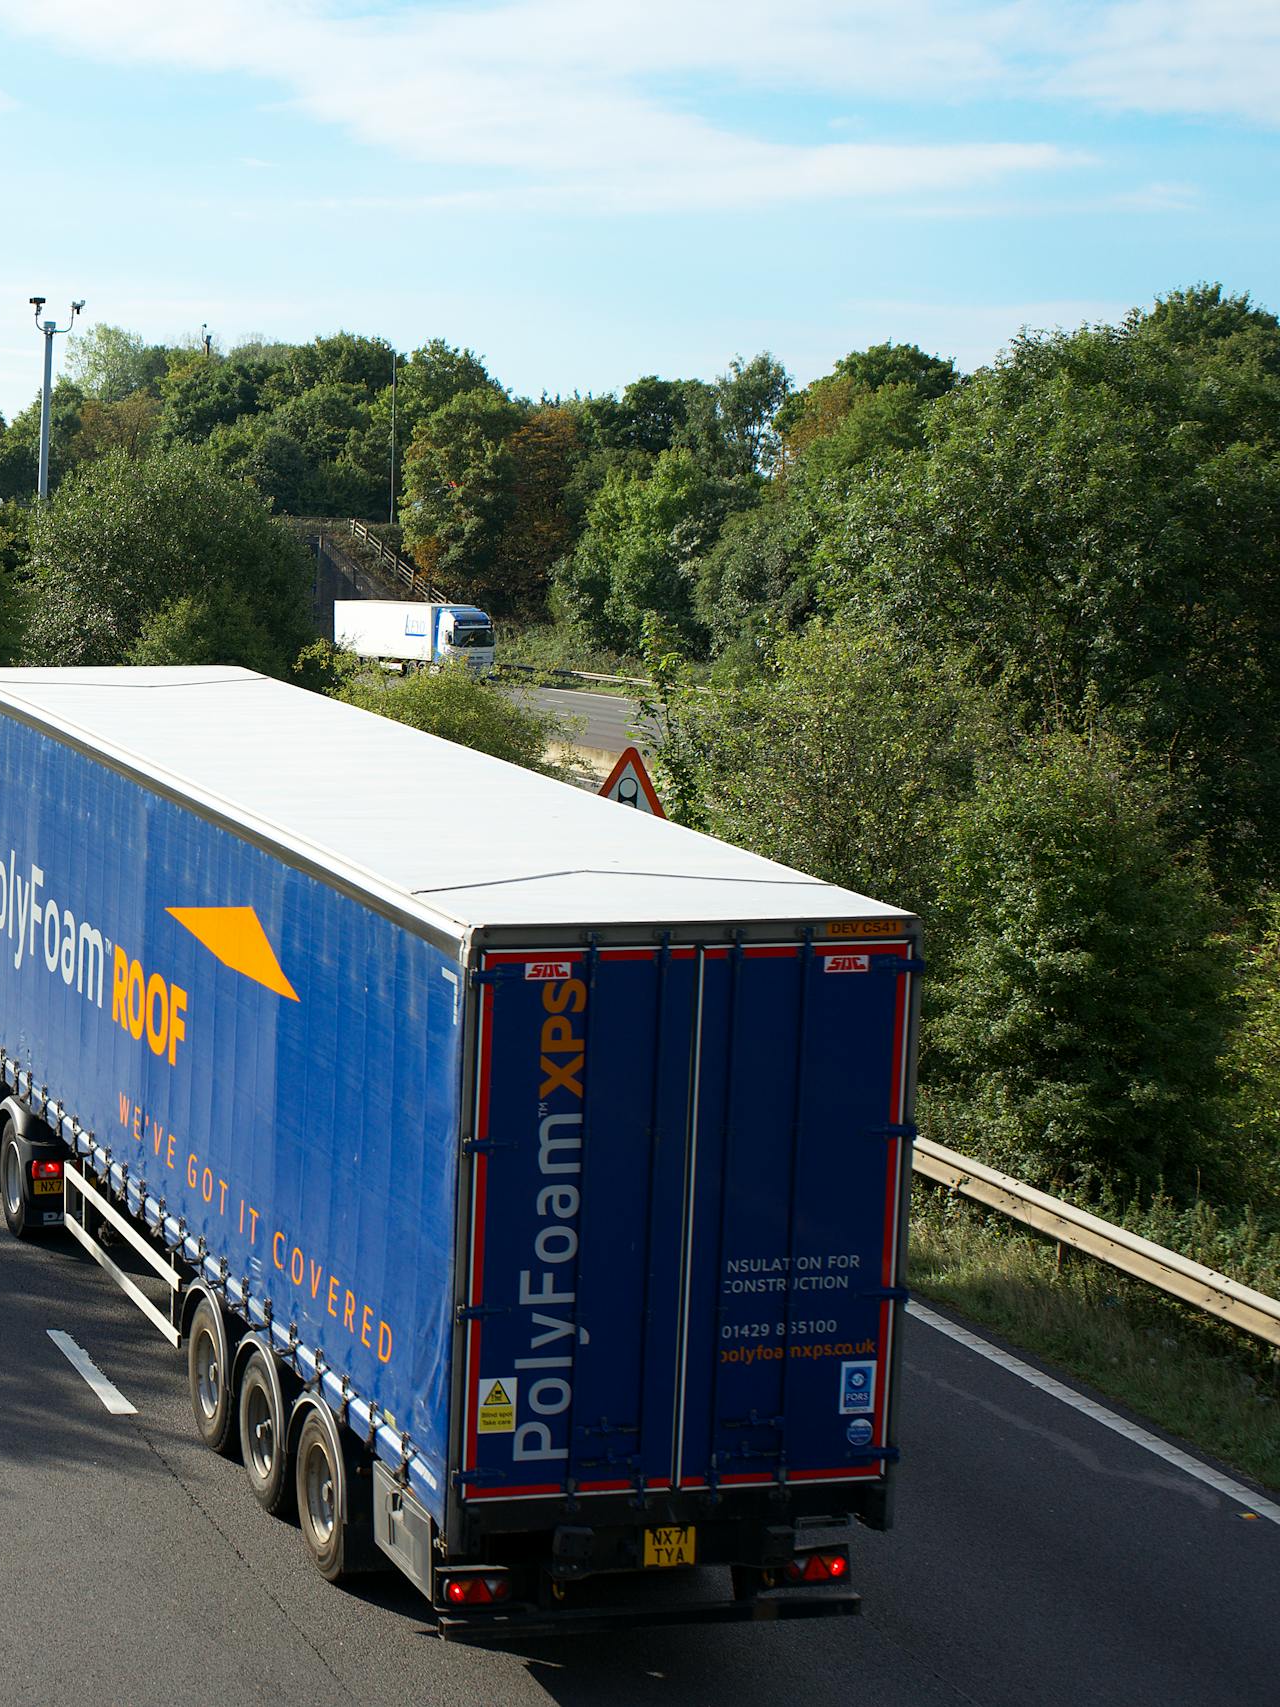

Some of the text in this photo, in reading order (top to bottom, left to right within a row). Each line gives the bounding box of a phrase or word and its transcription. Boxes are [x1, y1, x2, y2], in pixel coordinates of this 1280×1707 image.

[831, 921, 897, 934] DEV C541
[526, 963, 570, 979] SDC
[826, 956, 866, 971] SDC
[112, 944, 187, 1067] ROOF
[538, 978, 587, 1100] XPS
[40, 1180, 63, 1193] NX7
[119, 1091, 393, 1364] WE'VE GOT IT COVERED
[726, 1254, 860, 1273] NSULATON FOR
[721, 1323, 770, 1339] 01429
[846, 1392, 868, 1401] FORS
[652, 1530, 688, 1546] NX71
[654, 1547, 684, 1563] TYA
